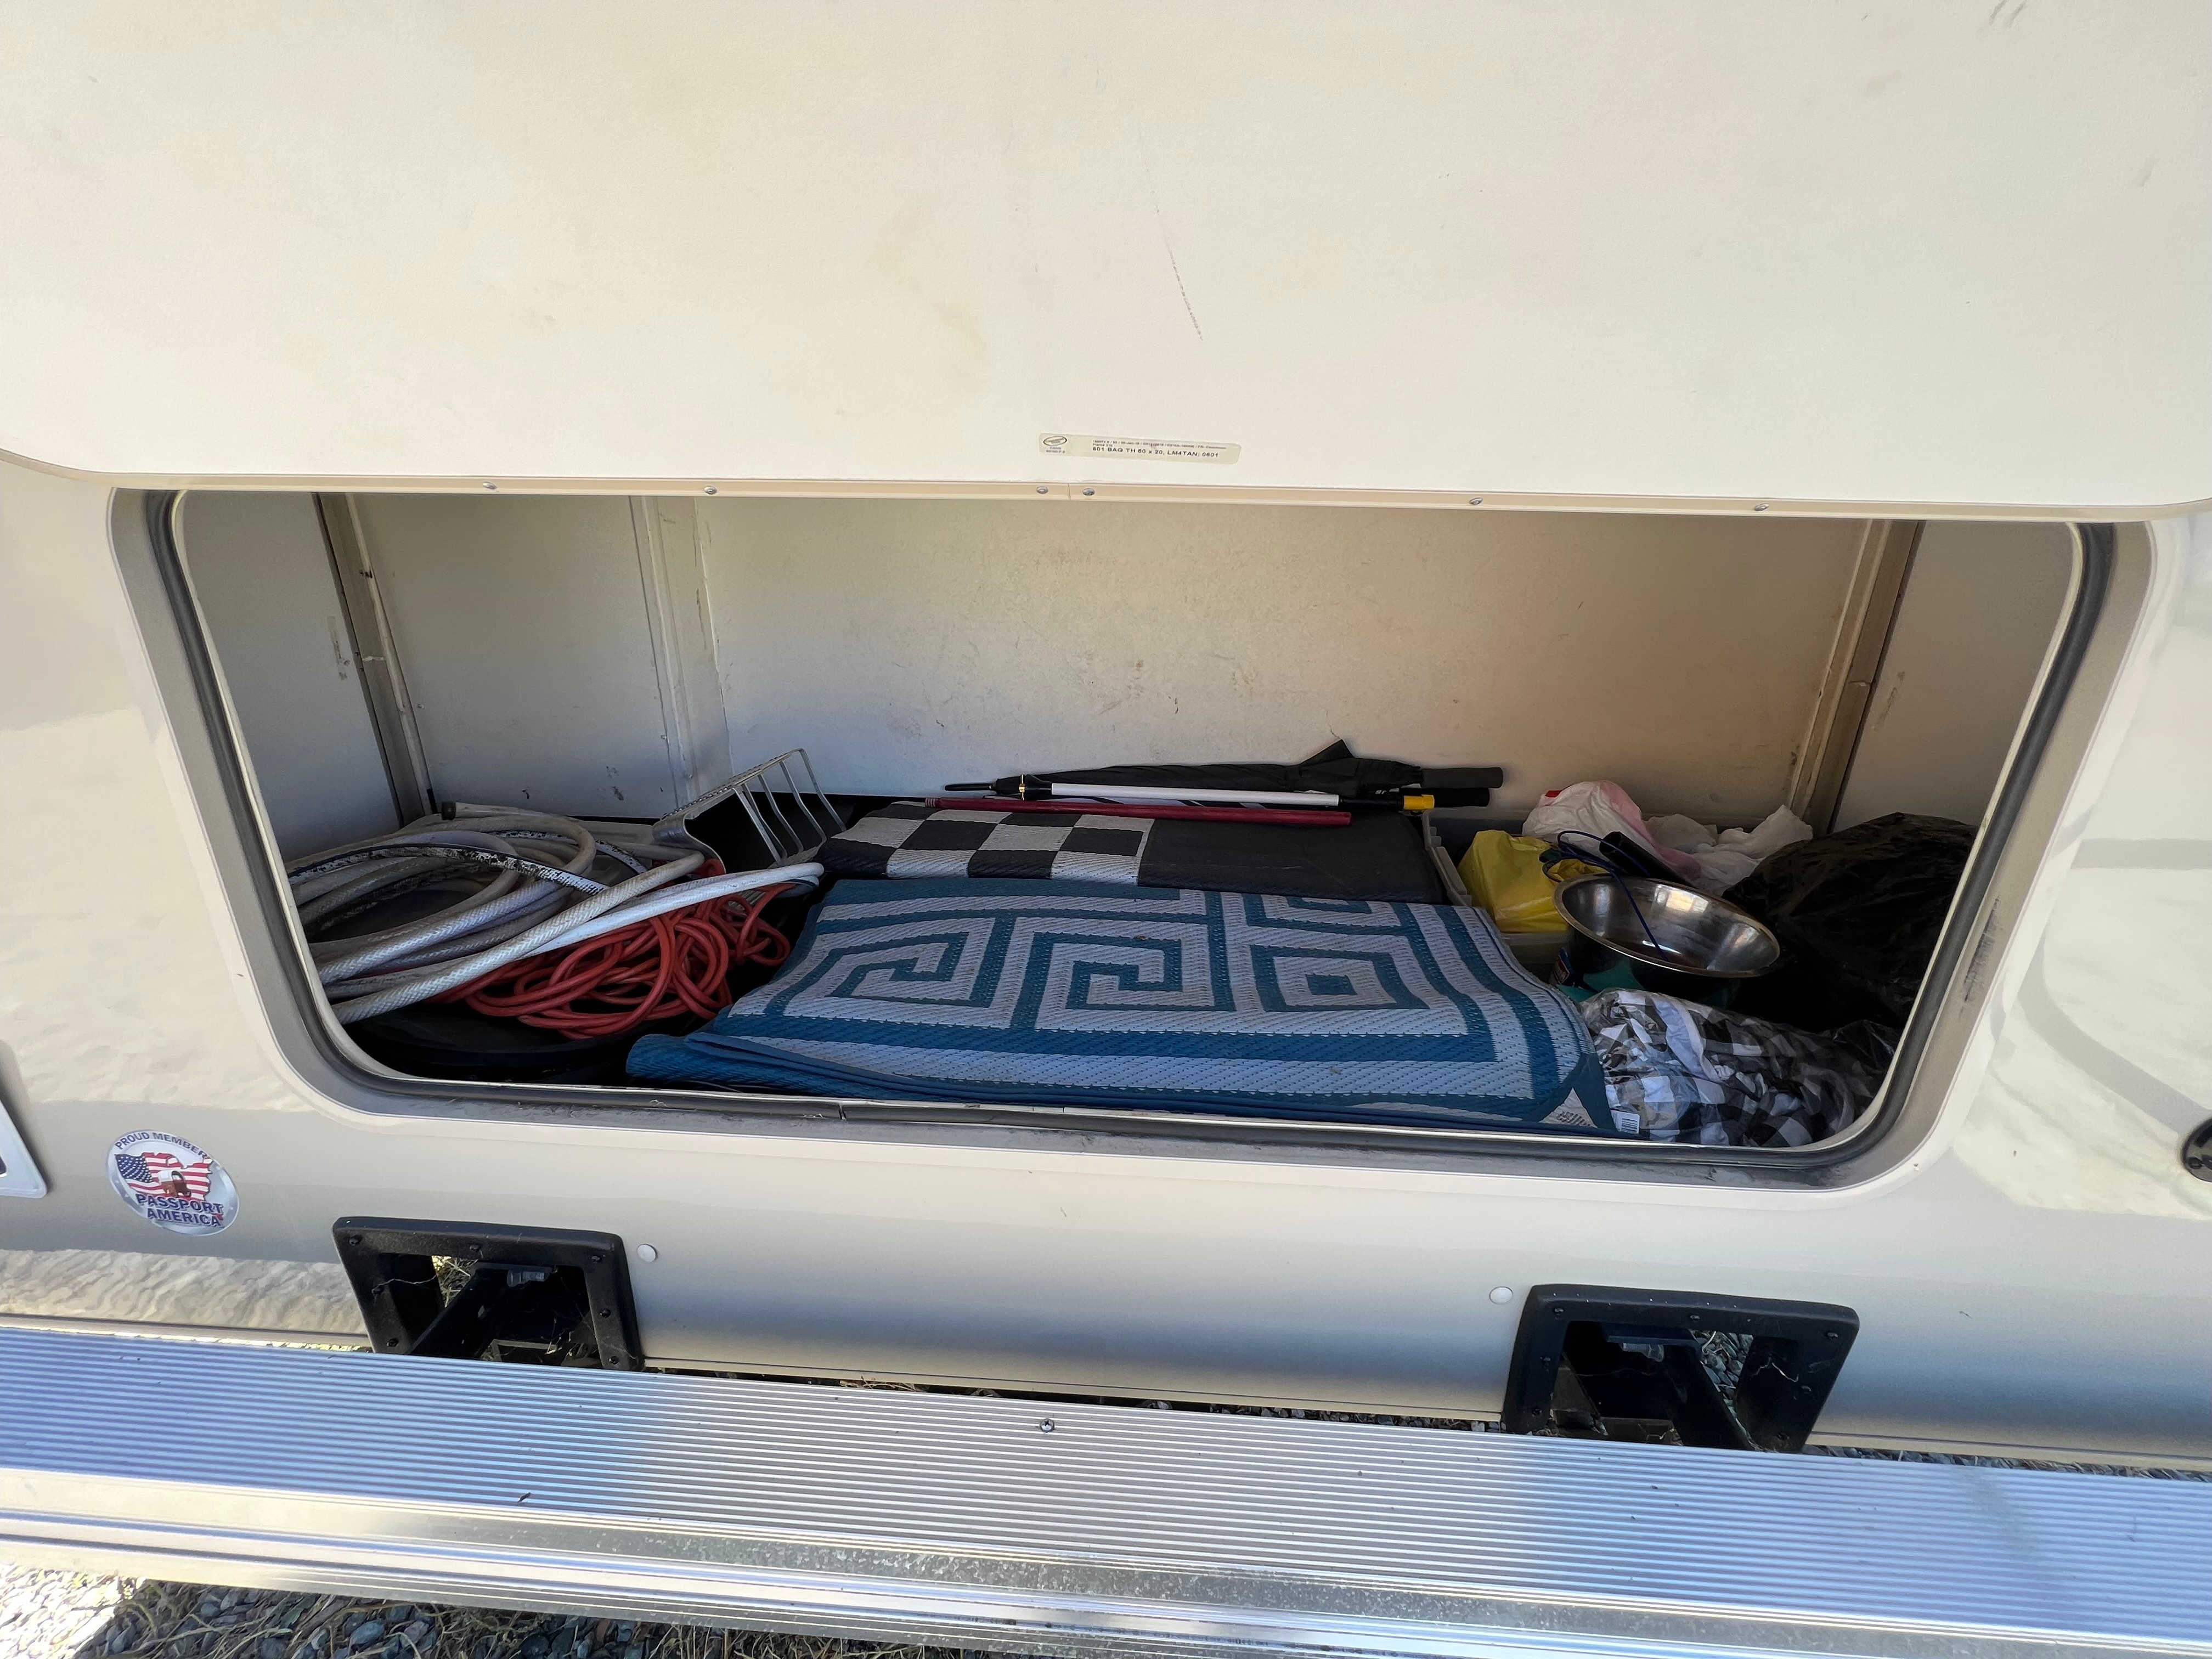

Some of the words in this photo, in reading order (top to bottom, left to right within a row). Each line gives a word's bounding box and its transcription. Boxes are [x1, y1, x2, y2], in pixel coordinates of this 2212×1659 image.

[114, 1132, 150, 1150] PROUD
[152, 1132, 212, 1160] MEMBER
[136, 1193, 224, 1214] PASSPORT
[147, 1208, 221, 1226] AMERICA
